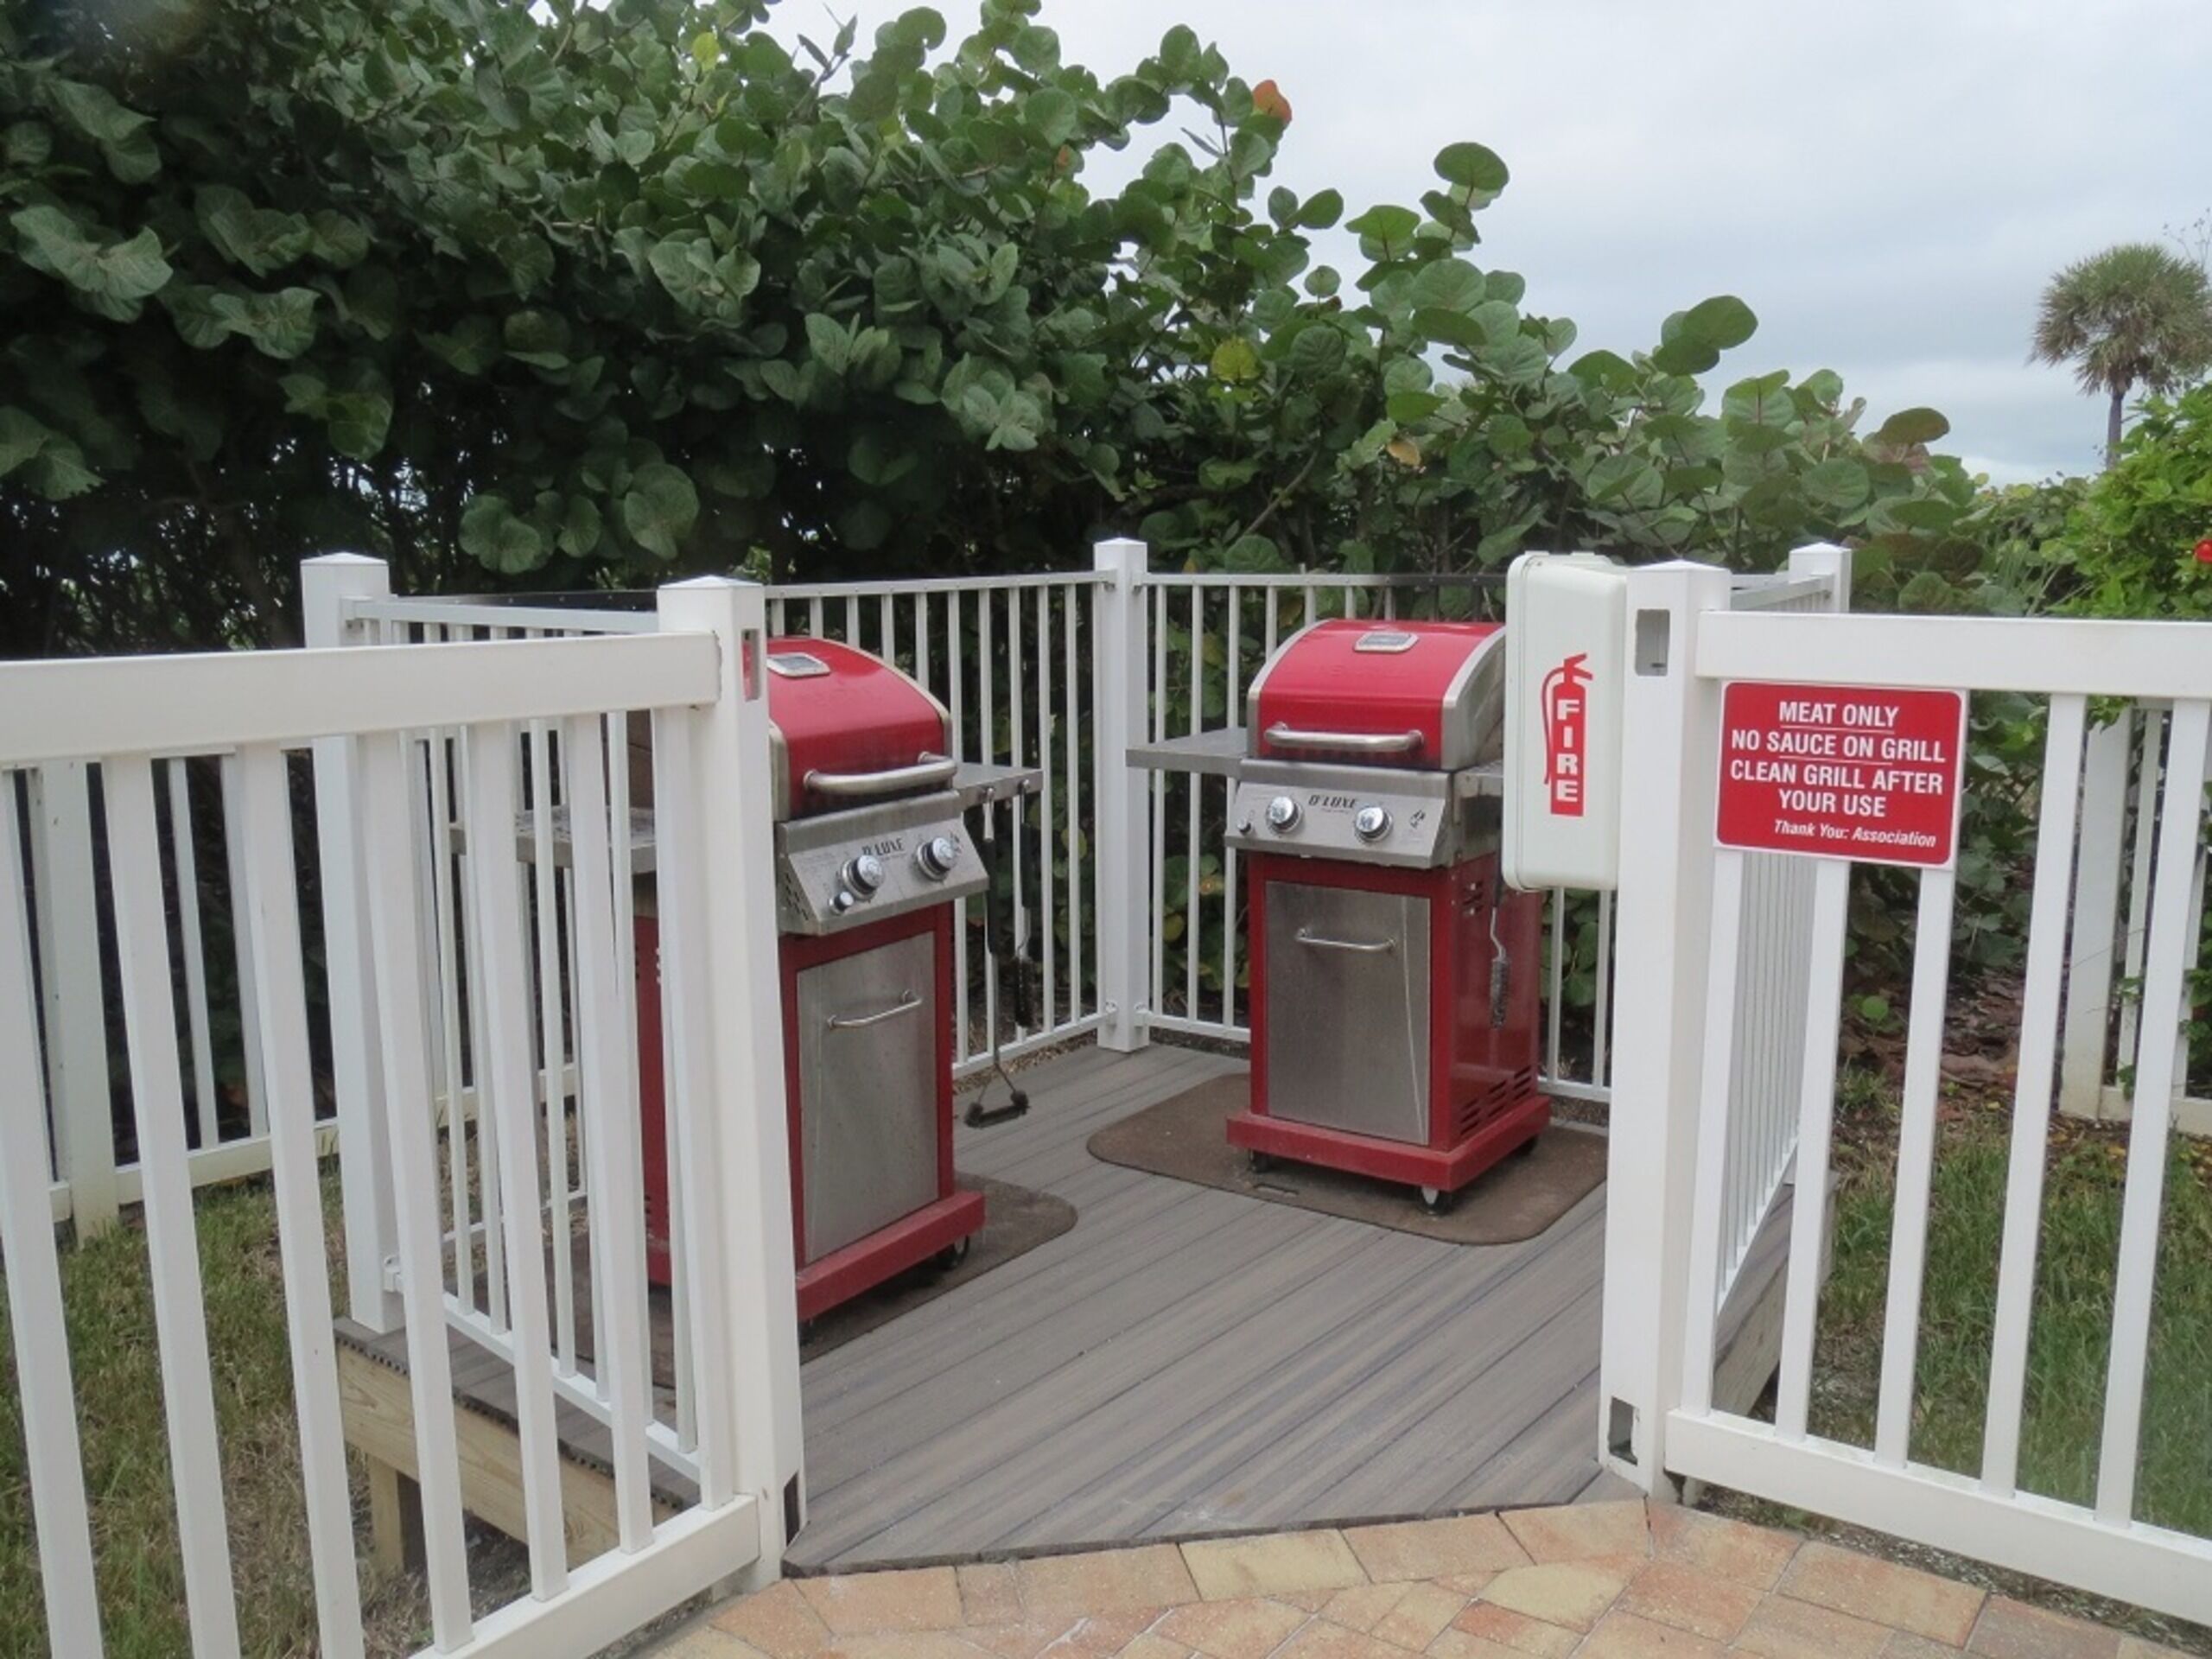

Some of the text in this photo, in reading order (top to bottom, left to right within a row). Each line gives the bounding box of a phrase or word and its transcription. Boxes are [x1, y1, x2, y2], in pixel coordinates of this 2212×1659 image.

[1779, 701, 1898, 728] MEAT ONLY
[1557, 699, 1580, 802] FIRE
[1732, 729, 1945, 762] NO SAUCE ON GRILL
[1731, 760, 1942, 794] CLEAN GRILL AFTER
[1779, 789, 1885, 817] YOUR USE
[1775, 819, 1815, 837] Thank
[1853, 827, 1936, 848] Association
